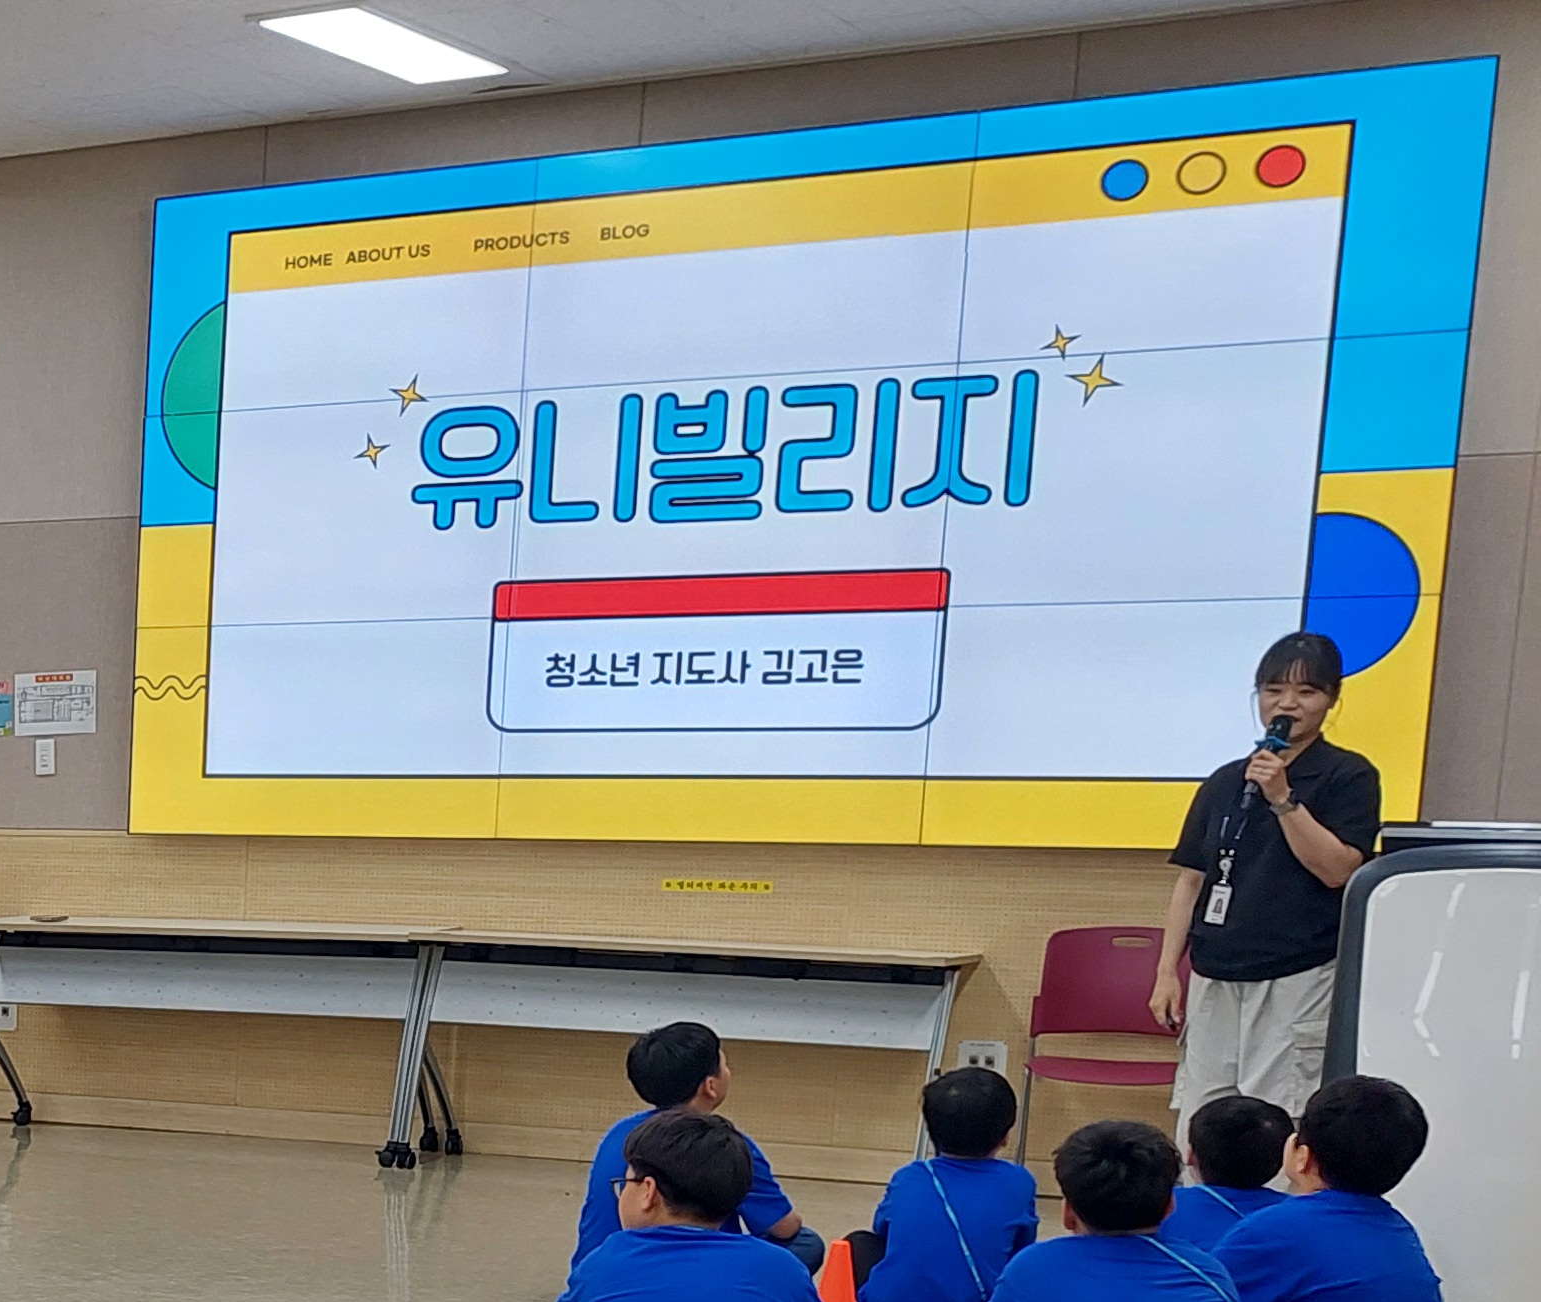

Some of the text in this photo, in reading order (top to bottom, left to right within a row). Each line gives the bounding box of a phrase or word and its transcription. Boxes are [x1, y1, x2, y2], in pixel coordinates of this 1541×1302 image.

[284, 223, 650, 270] HOME ABOUT US PRODUCTS BLOG
[411, 369, 1040, 531] 유니빌리지
[545, 648, 864, 687] 청소년 지도사 김고은
